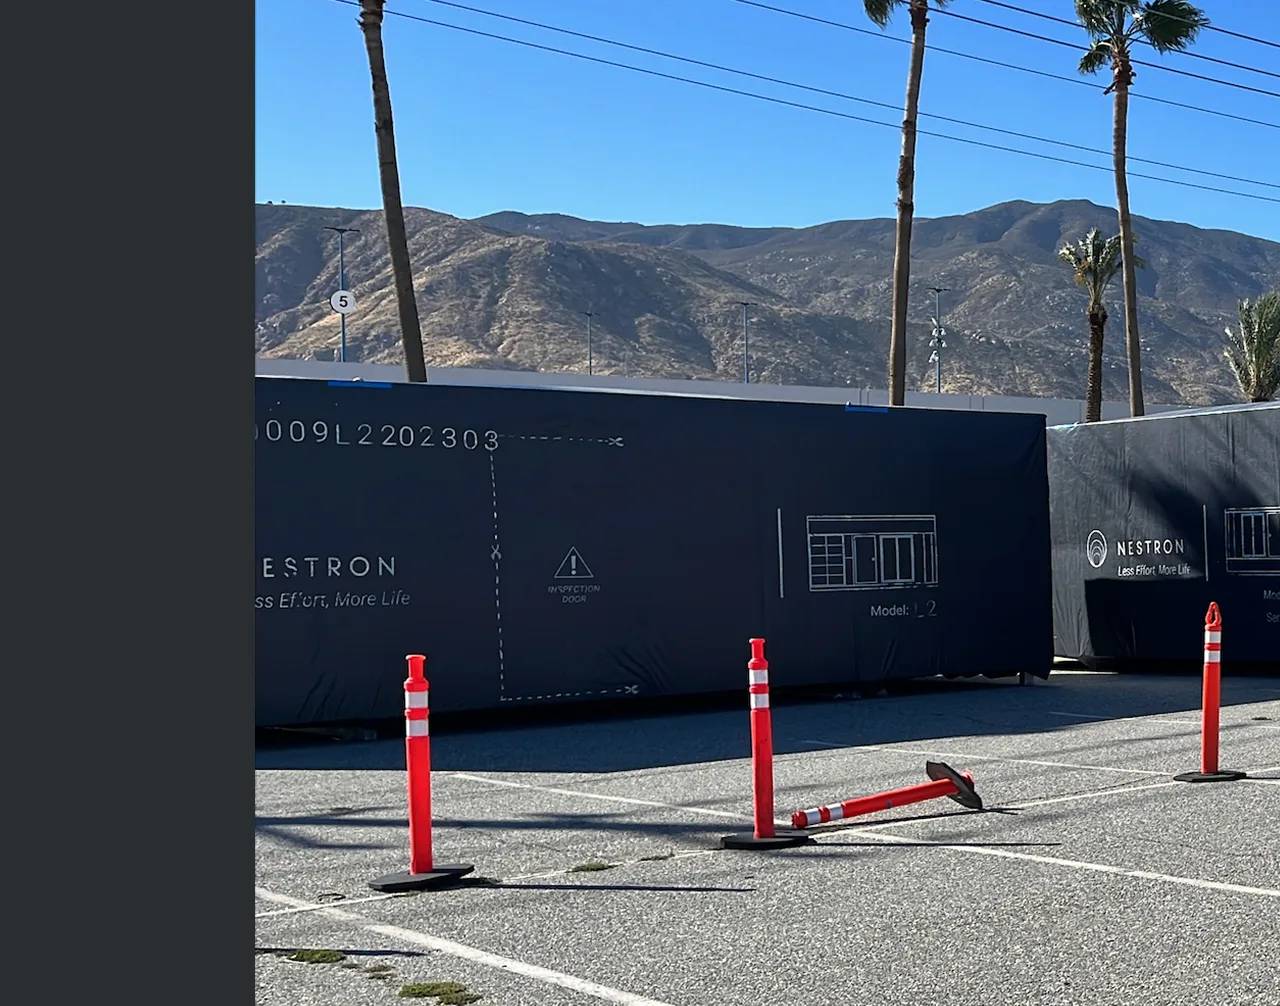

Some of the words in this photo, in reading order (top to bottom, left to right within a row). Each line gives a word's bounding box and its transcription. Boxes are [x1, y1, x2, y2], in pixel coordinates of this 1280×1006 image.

[339, 295, 348, 308] 5
[255, 418, 499, 451] 009L2202303
[1116, 538, 1185, 557] NESTRON
[1117, 565, 1136, 577] Less
[1158, 564, 1177, 576] More
[1178, 562, 1191, 576] Life
[334, 591, 377, 607] More
[381, 589, 411, 606] Life
[562, 595, 587, 604] DOOR
[870, 603, 910, 617] Model:
